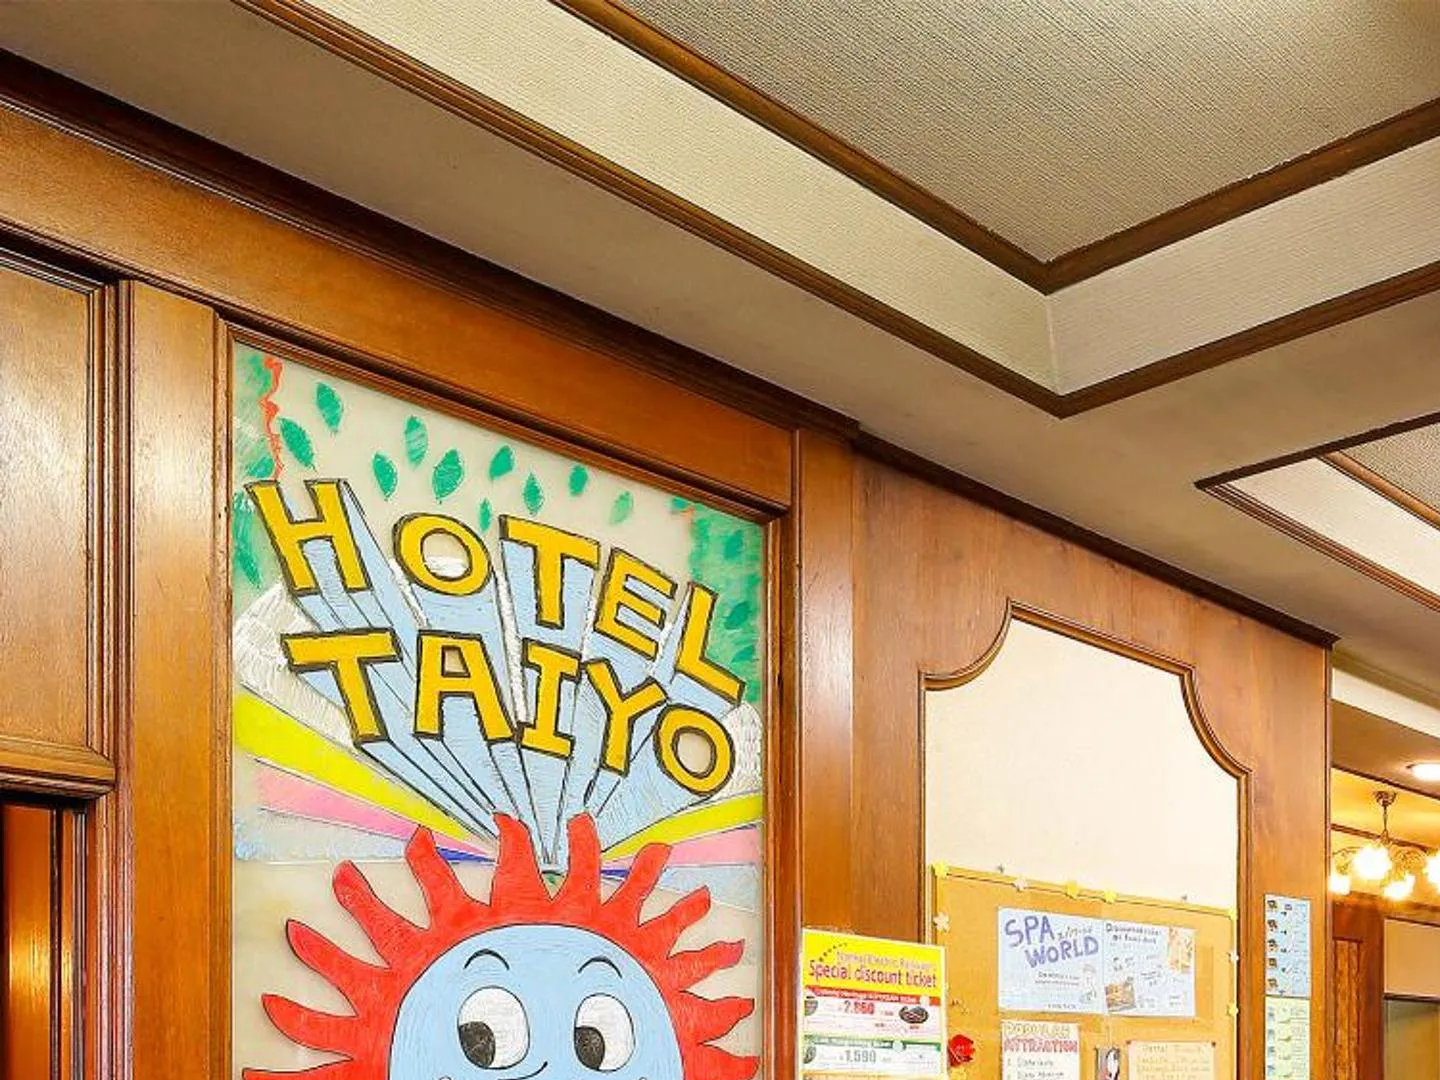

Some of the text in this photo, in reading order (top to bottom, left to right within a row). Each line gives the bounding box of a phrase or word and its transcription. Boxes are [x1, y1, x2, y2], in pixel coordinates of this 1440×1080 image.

[245, 478, 746, 706] HOTEL
[280, 627, 735, 795] TAIYO
[1004, 915, 1055, 948] SPA
[1024, 936, 1099, 968] WORLD
[854, 964, 902, 985] discount
[906, 969, 937, 988] ticket
